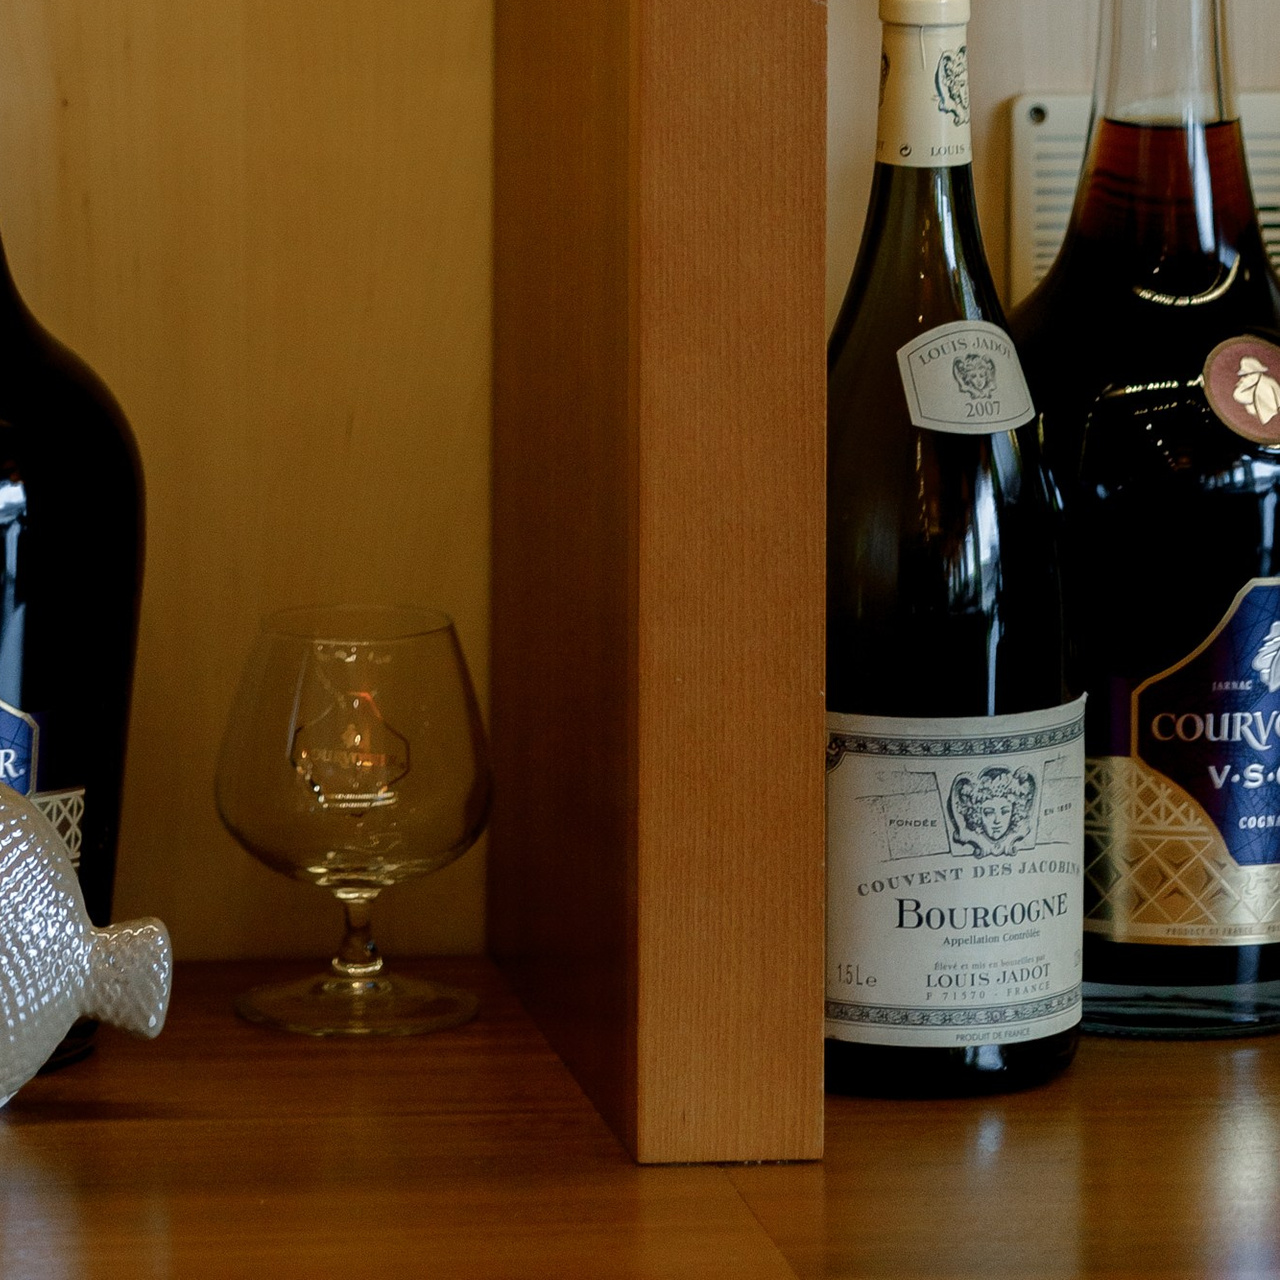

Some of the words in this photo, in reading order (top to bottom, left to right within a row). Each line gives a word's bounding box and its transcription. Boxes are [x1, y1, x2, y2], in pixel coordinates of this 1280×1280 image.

[918, 338, 968, 365] LOUIS
[965, 401, 1001, 418] 2007
[1151, 710, 1280, 751] COURV
[888, 818, 938, 828] FONDÉE
[857, 867, 963, 897] COUVENT
[973, 863, 1013, 879] DES
[942, 935, 1000, 948] Appellation
[926, 973, 990, 988] LOUIS
[996, 962, 1051, 985] JADOT
[1006, 981, 1050, 997] FRANCE
[955, 1032, 990, 1041] PRODUIT
[992, 1031, 1002, 1039] DE
[1004, 1027, 1031, 1038] FRANCE
